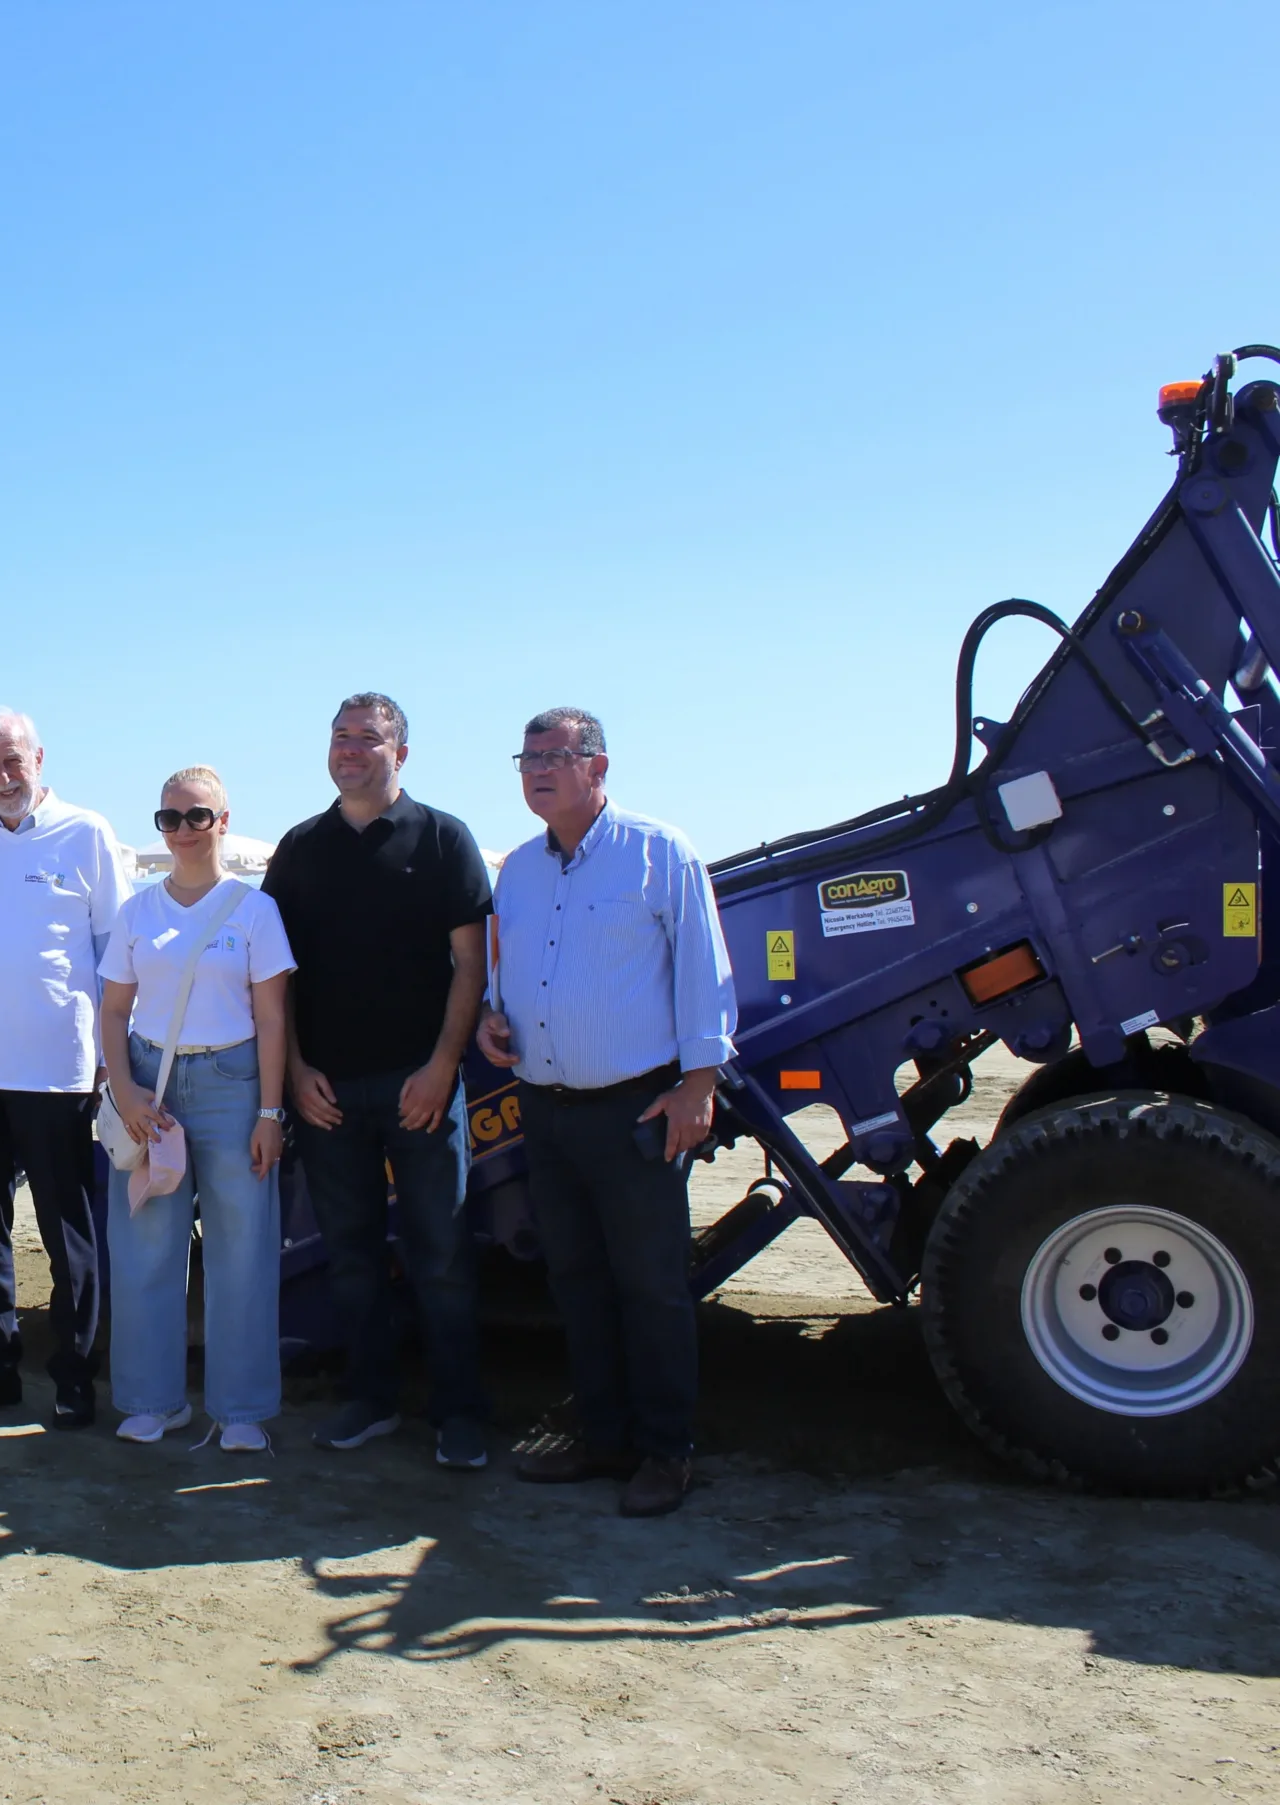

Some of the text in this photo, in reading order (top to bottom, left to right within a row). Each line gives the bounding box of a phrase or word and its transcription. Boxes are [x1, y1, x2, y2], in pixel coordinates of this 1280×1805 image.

[824, 915, 845, 924] Nicosia
[846, 911, 874, 921] Workshop
[825, 923, 856, 933] Emergency
[857, 919, 876, 928] Hotline
